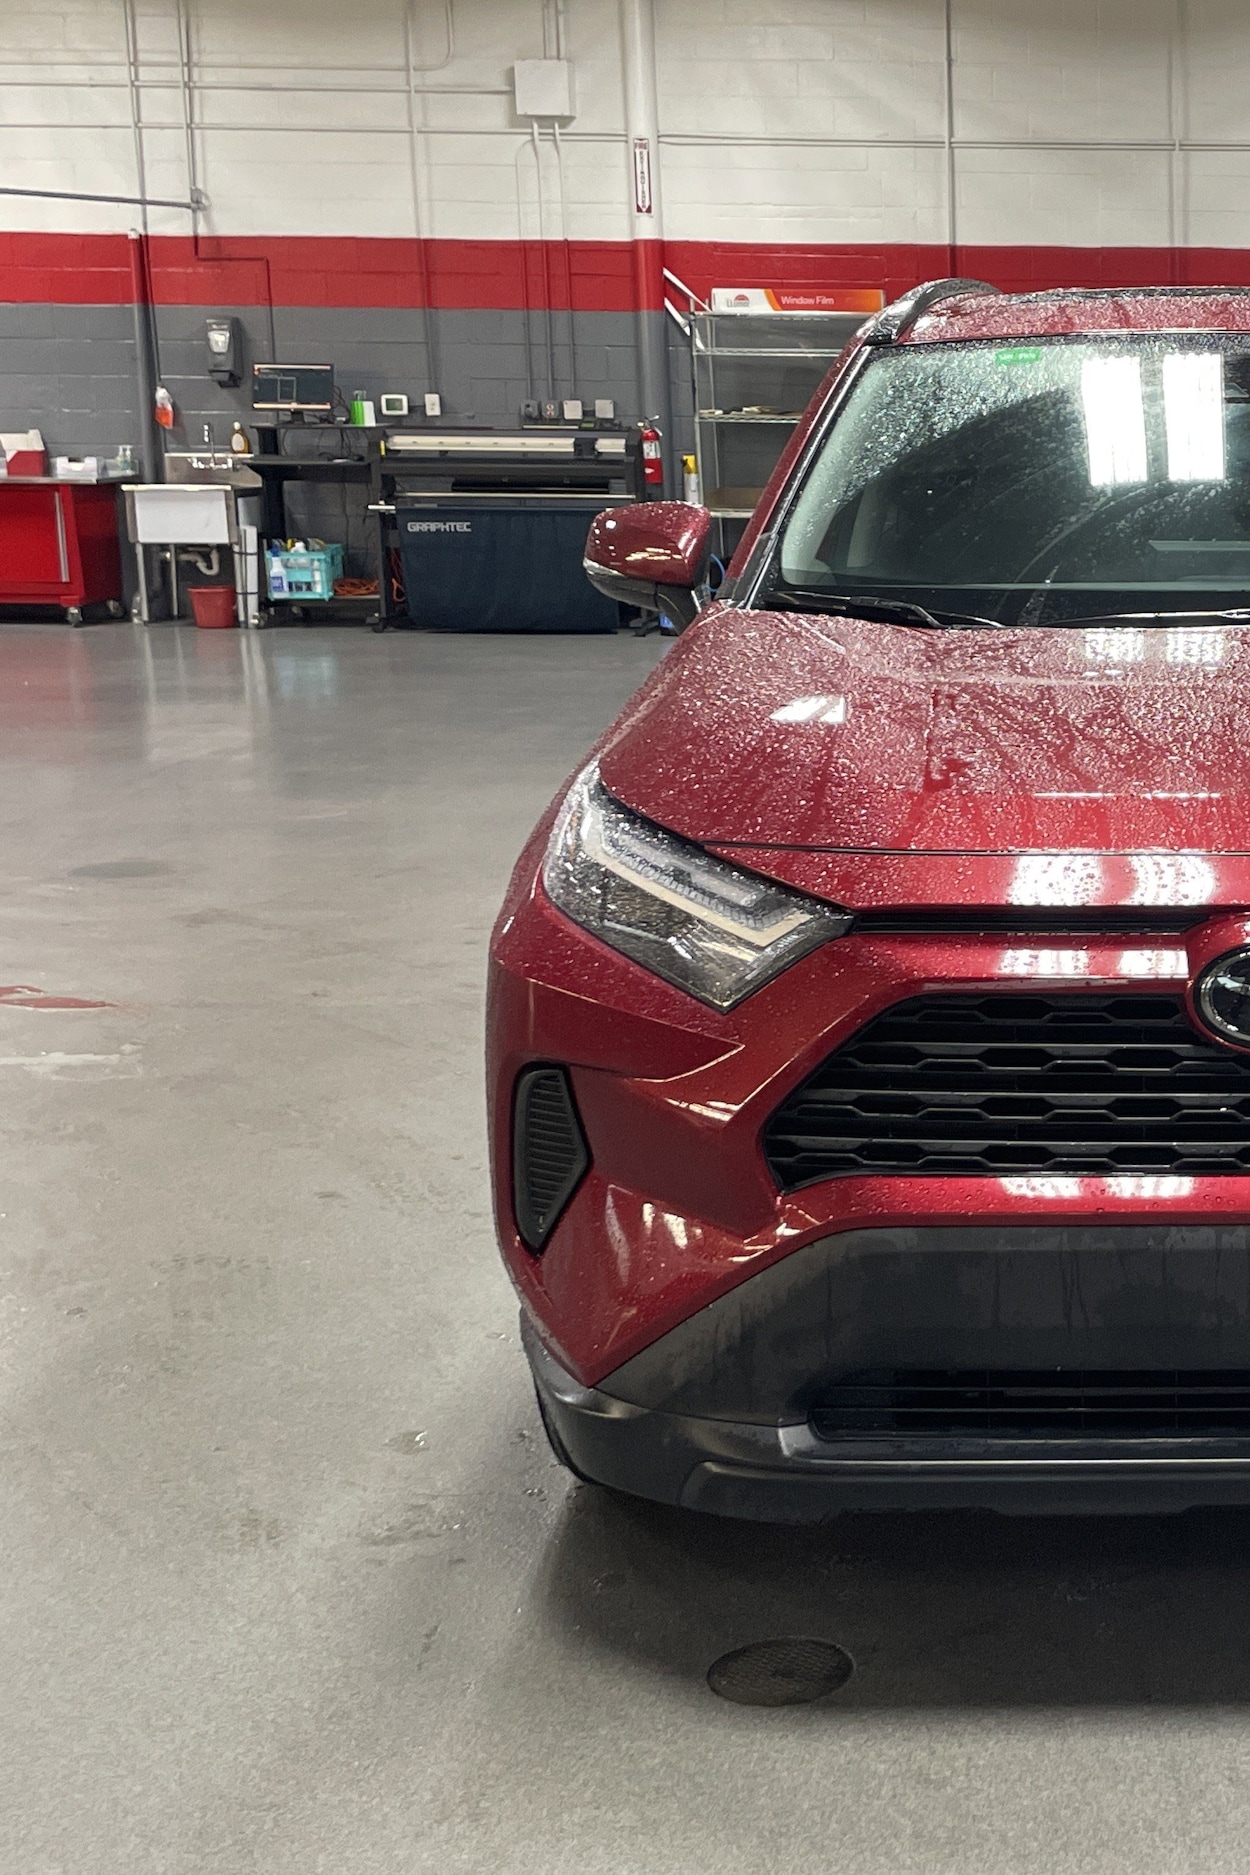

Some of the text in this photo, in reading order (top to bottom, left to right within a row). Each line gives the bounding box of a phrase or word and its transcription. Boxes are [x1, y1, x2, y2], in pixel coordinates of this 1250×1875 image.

[780, 295, 835, 305] Window Film
[407, 521, 472, 533] GRAPHTEC
